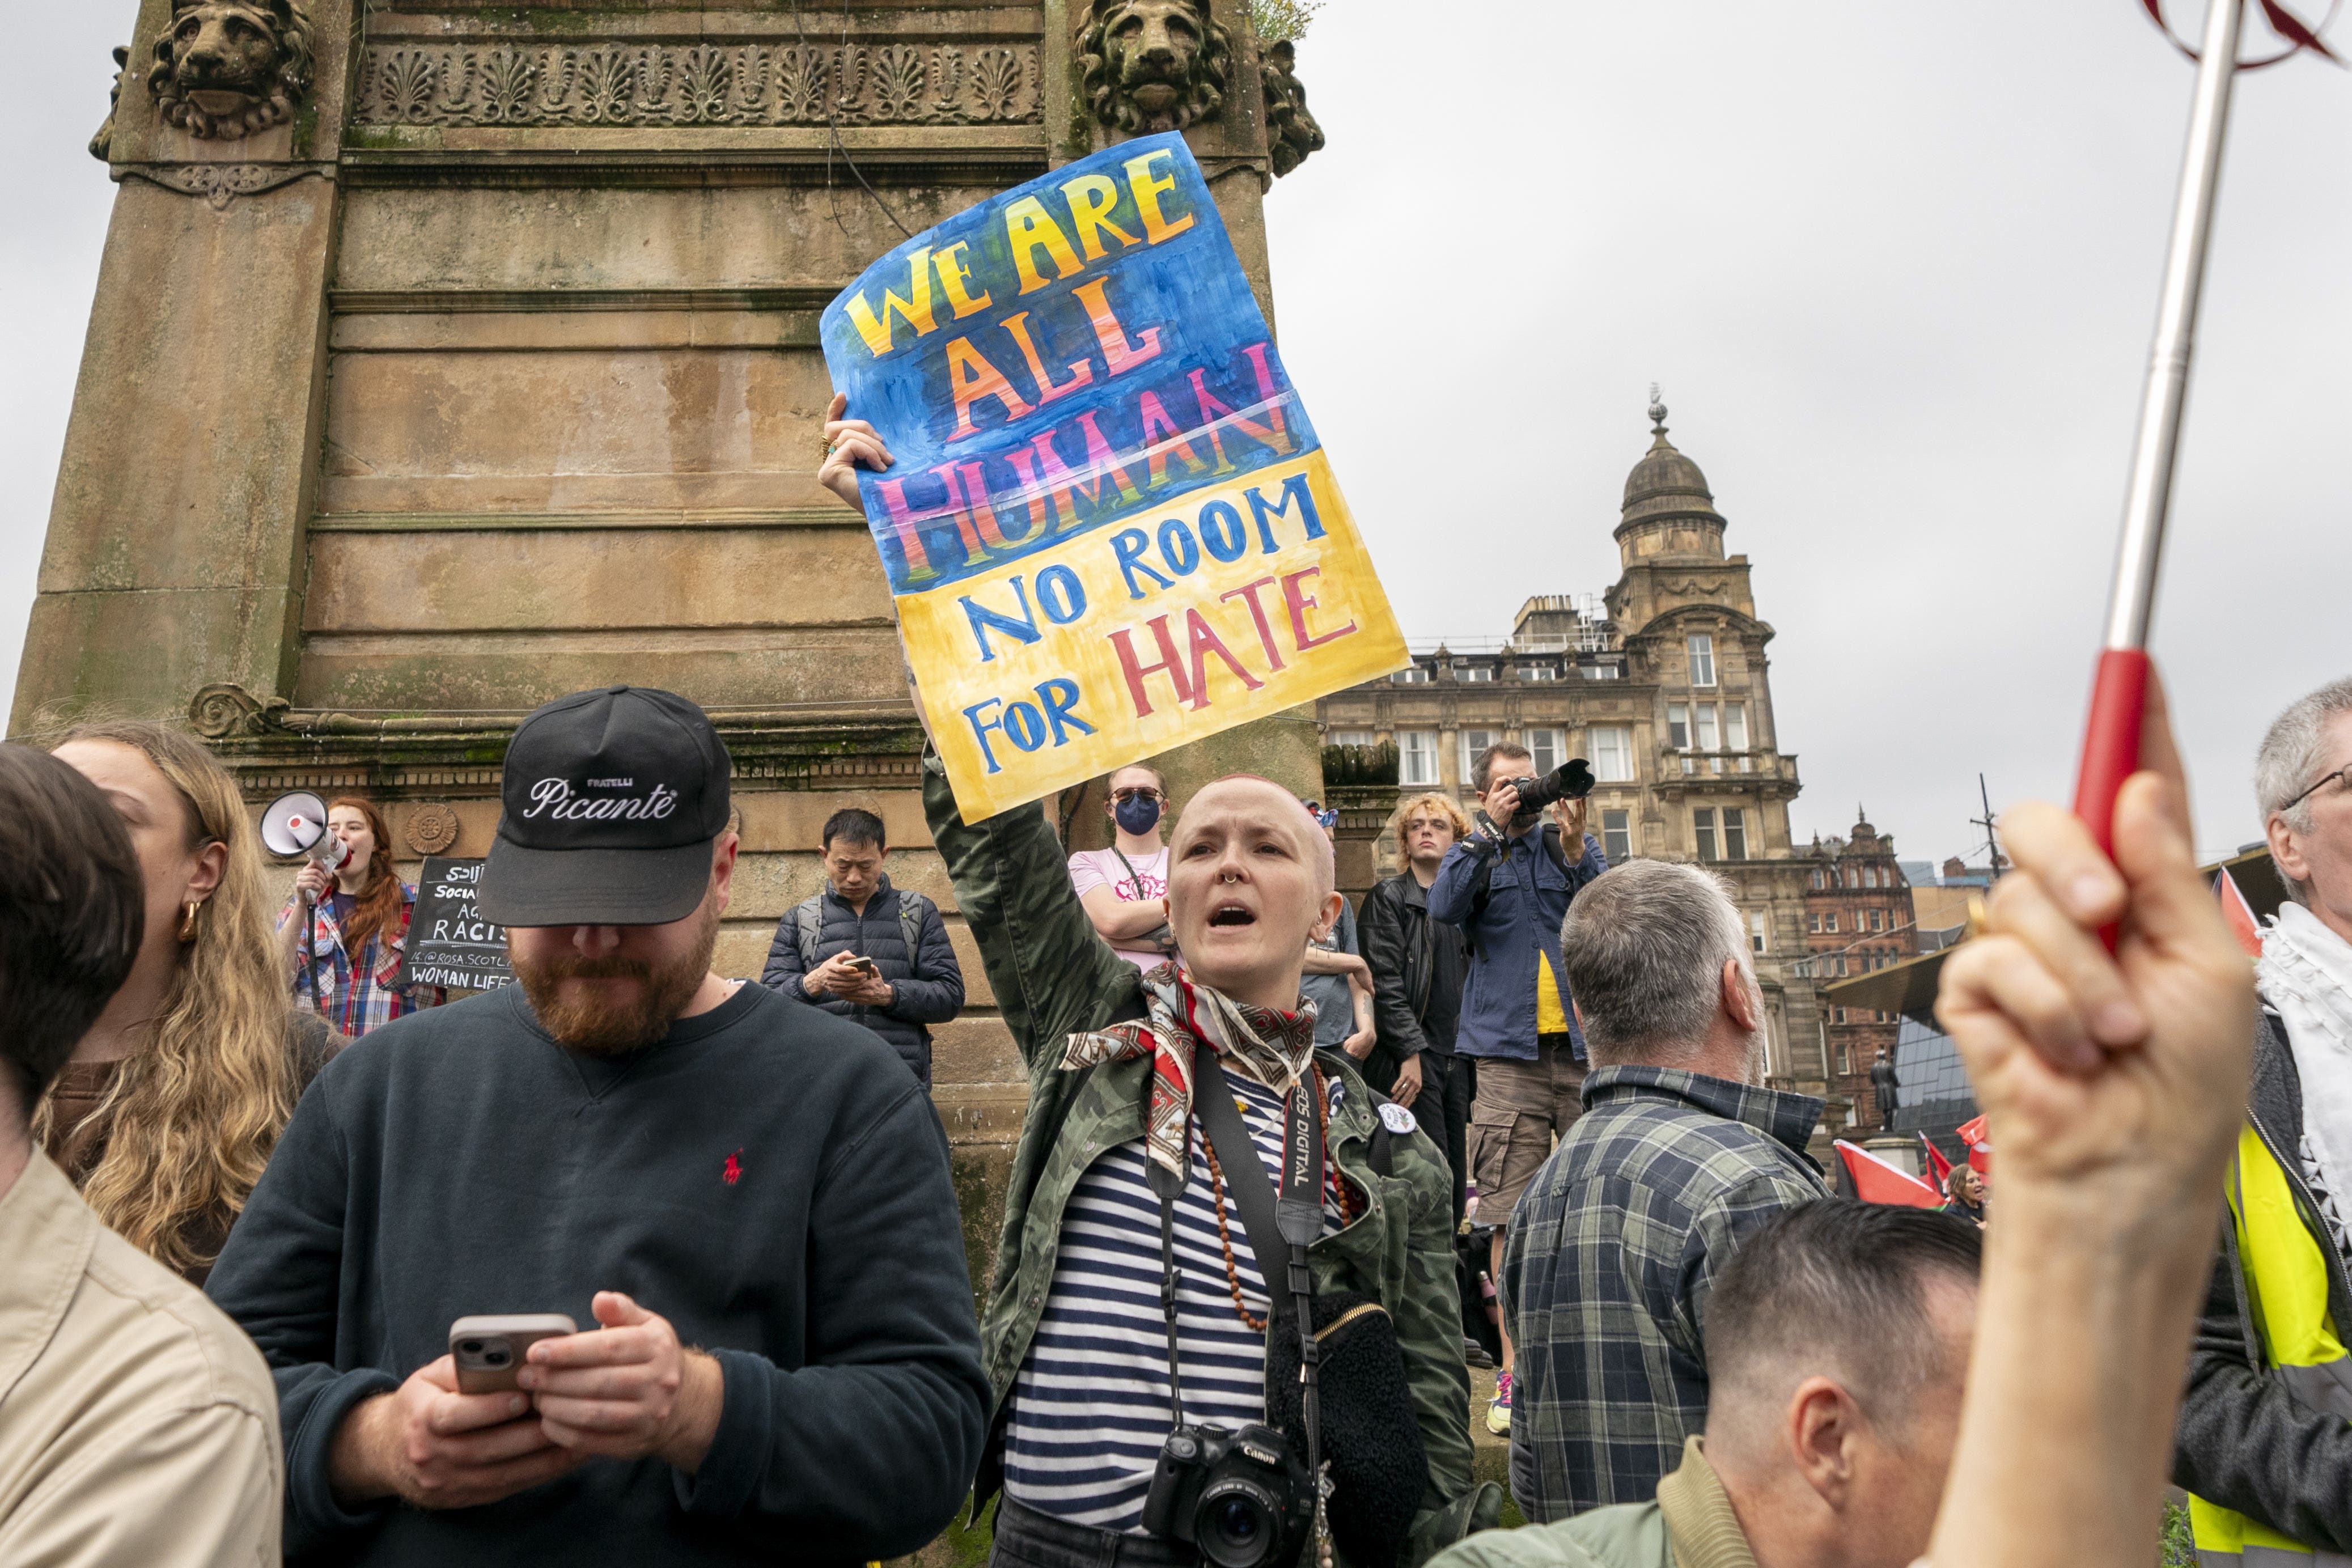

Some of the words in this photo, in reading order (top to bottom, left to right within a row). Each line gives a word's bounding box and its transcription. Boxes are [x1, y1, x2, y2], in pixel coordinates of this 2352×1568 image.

[844, 245, 993, 357] WE
[1005, 149, 1195, 296] ARE
[944, 276, 1162, 443] ALL
[875, 342, 1299, 581] HUMAN
[958, 565, 1087, 662] NO
[1109, 472, 1328, 600] ROOM
[963, 679, 1097, 774] FOR
[1107, 566, 1357, 718] HATE
[523, 777, 677, 820] Picante
[587, 778, 633, 787] FRATELLI
[1495, 833, 1505, 842] Z
[434, 885, 480, 900] SOCIA
[457, 904, 483, 921] AG
[412, 966, 469, 988] WOMAN
[473, 974, 511, 990] LIFE
[1296, 1086, 1311, 1118] EOS
[1294, 1119, 1310, 1187] DIGITAL
[1243, 1446, 1276, 1465] Canon
